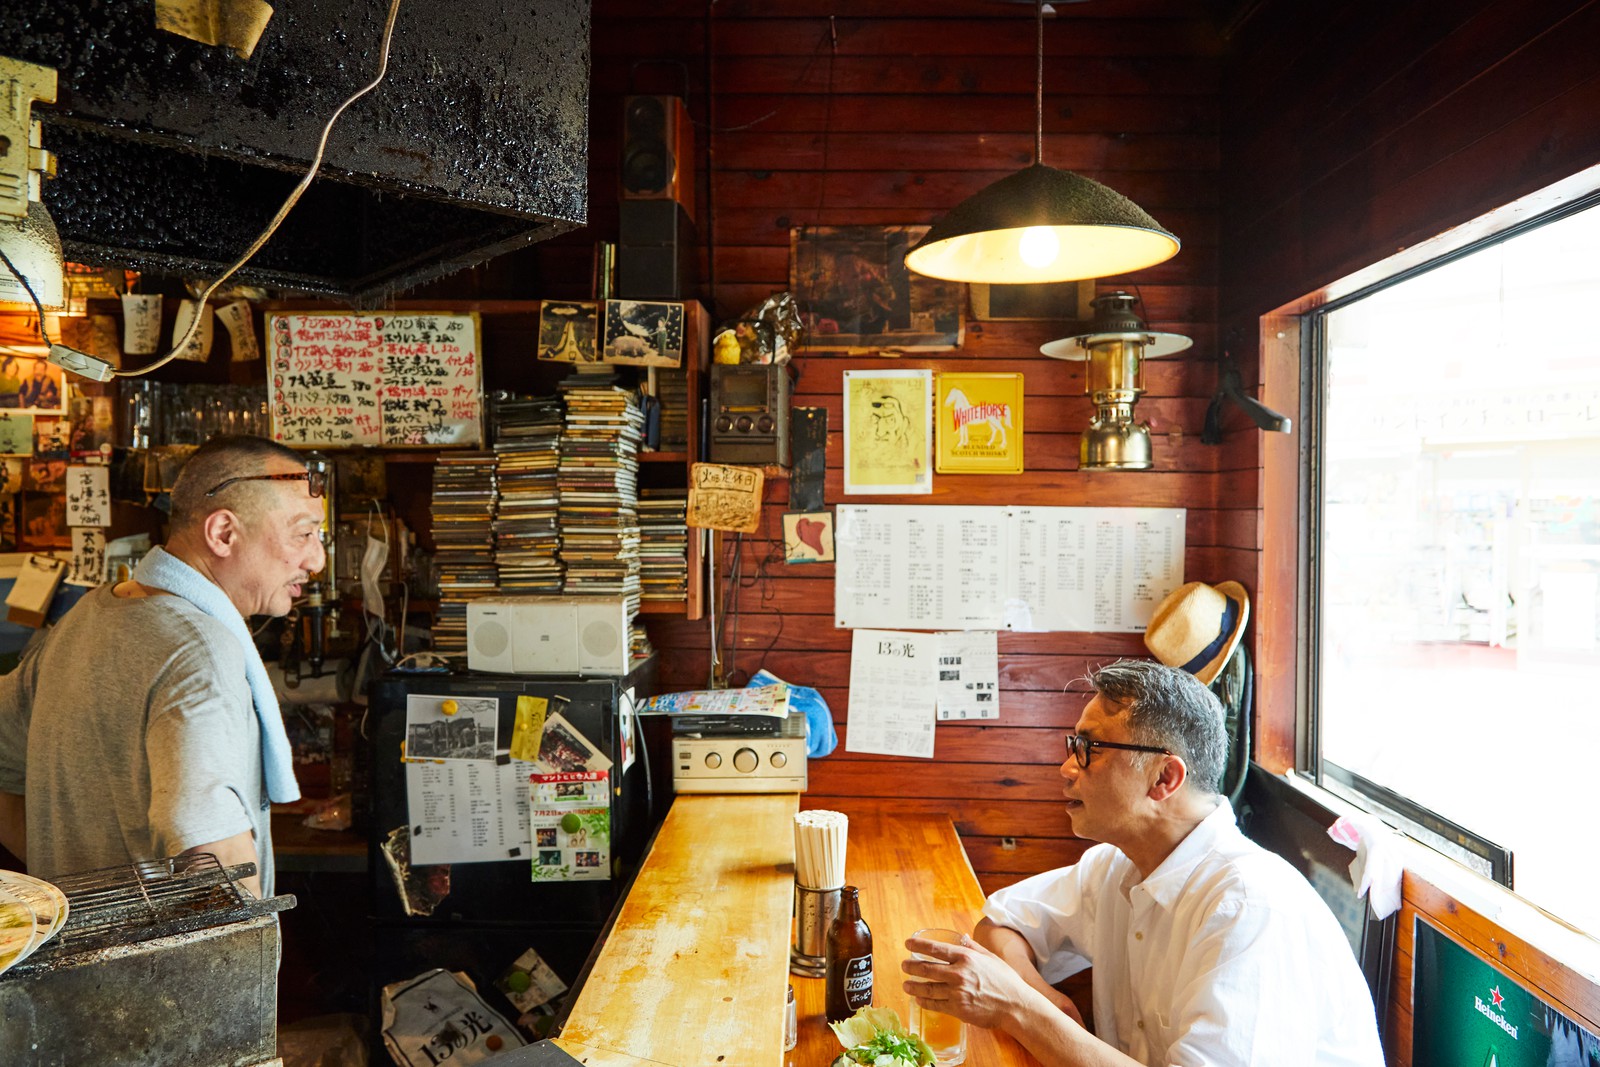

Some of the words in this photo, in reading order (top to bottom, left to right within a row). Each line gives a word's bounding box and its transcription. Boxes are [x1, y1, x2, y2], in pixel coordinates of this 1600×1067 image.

[441, 344, 460, 353] 320
[877, 641, 915, 658] 13の光
[1474, 995, 1518, 1040] Heineken
